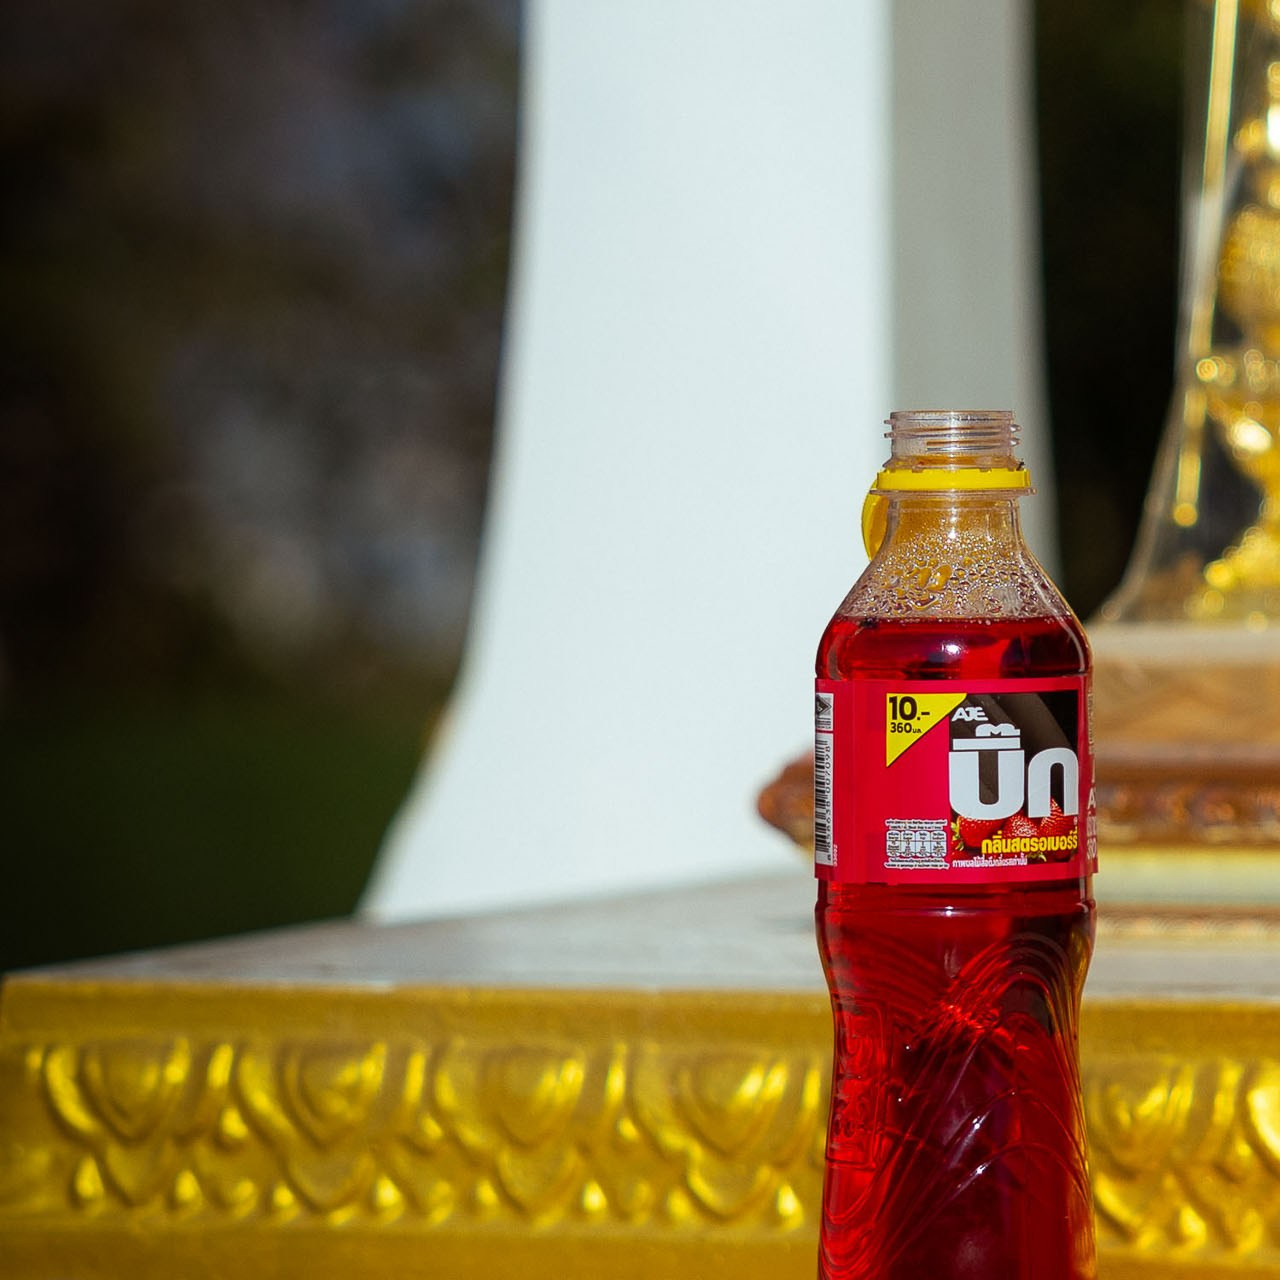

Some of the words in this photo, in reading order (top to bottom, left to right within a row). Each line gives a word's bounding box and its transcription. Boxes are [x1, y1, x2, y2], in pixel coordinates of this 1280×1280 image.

[889, 696, 930, 721] 10.-
[951, 706, 989, 722] AJE
[949, 723, 1079, 820] บิ๊ก
